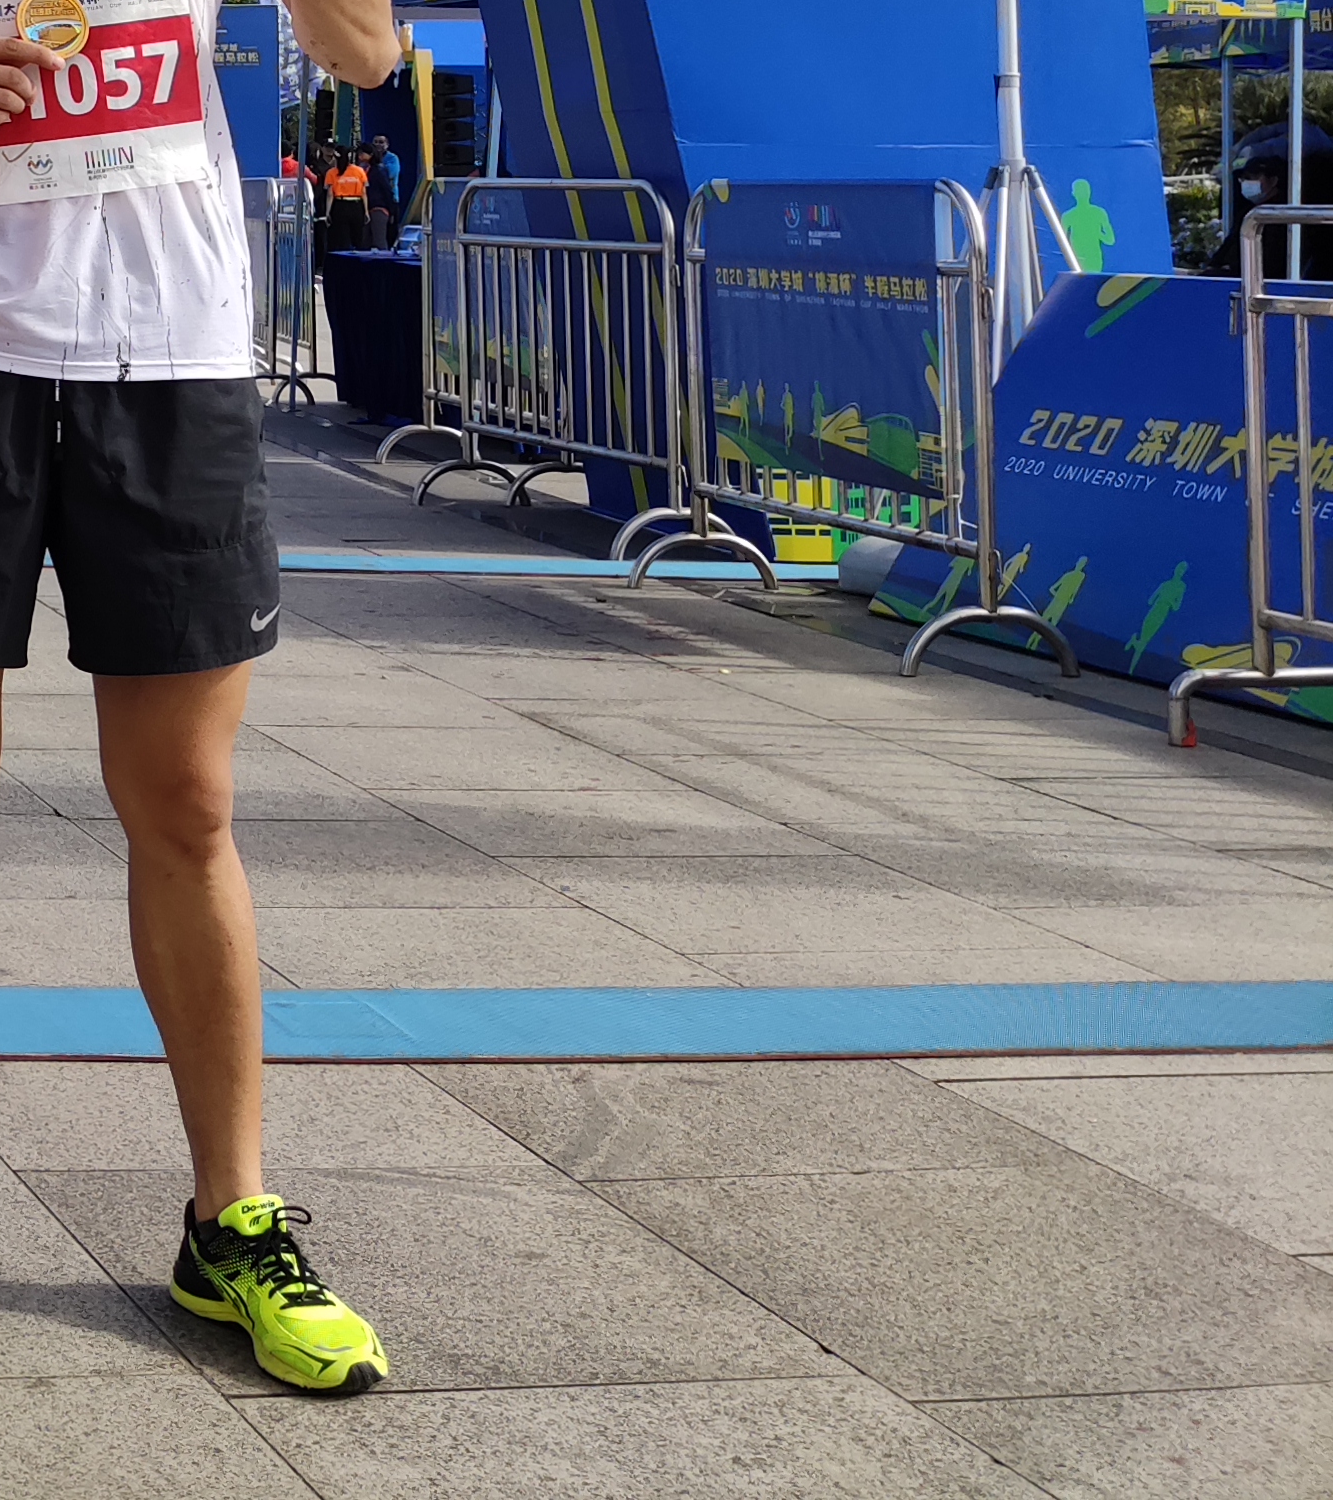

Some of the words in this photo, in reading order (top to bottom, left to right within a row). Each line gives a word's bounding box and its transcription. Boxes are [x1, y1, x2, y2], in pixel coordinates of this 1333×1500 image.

[715, 267, 744, 286] 2020
[1019, 408, 1123, 457] 2020
[1003, 456, 1046, 480] 2020
[1052, 463, 1157, 493] UNIVERSITY
[1172, 479, 1228, 504] TOWN
